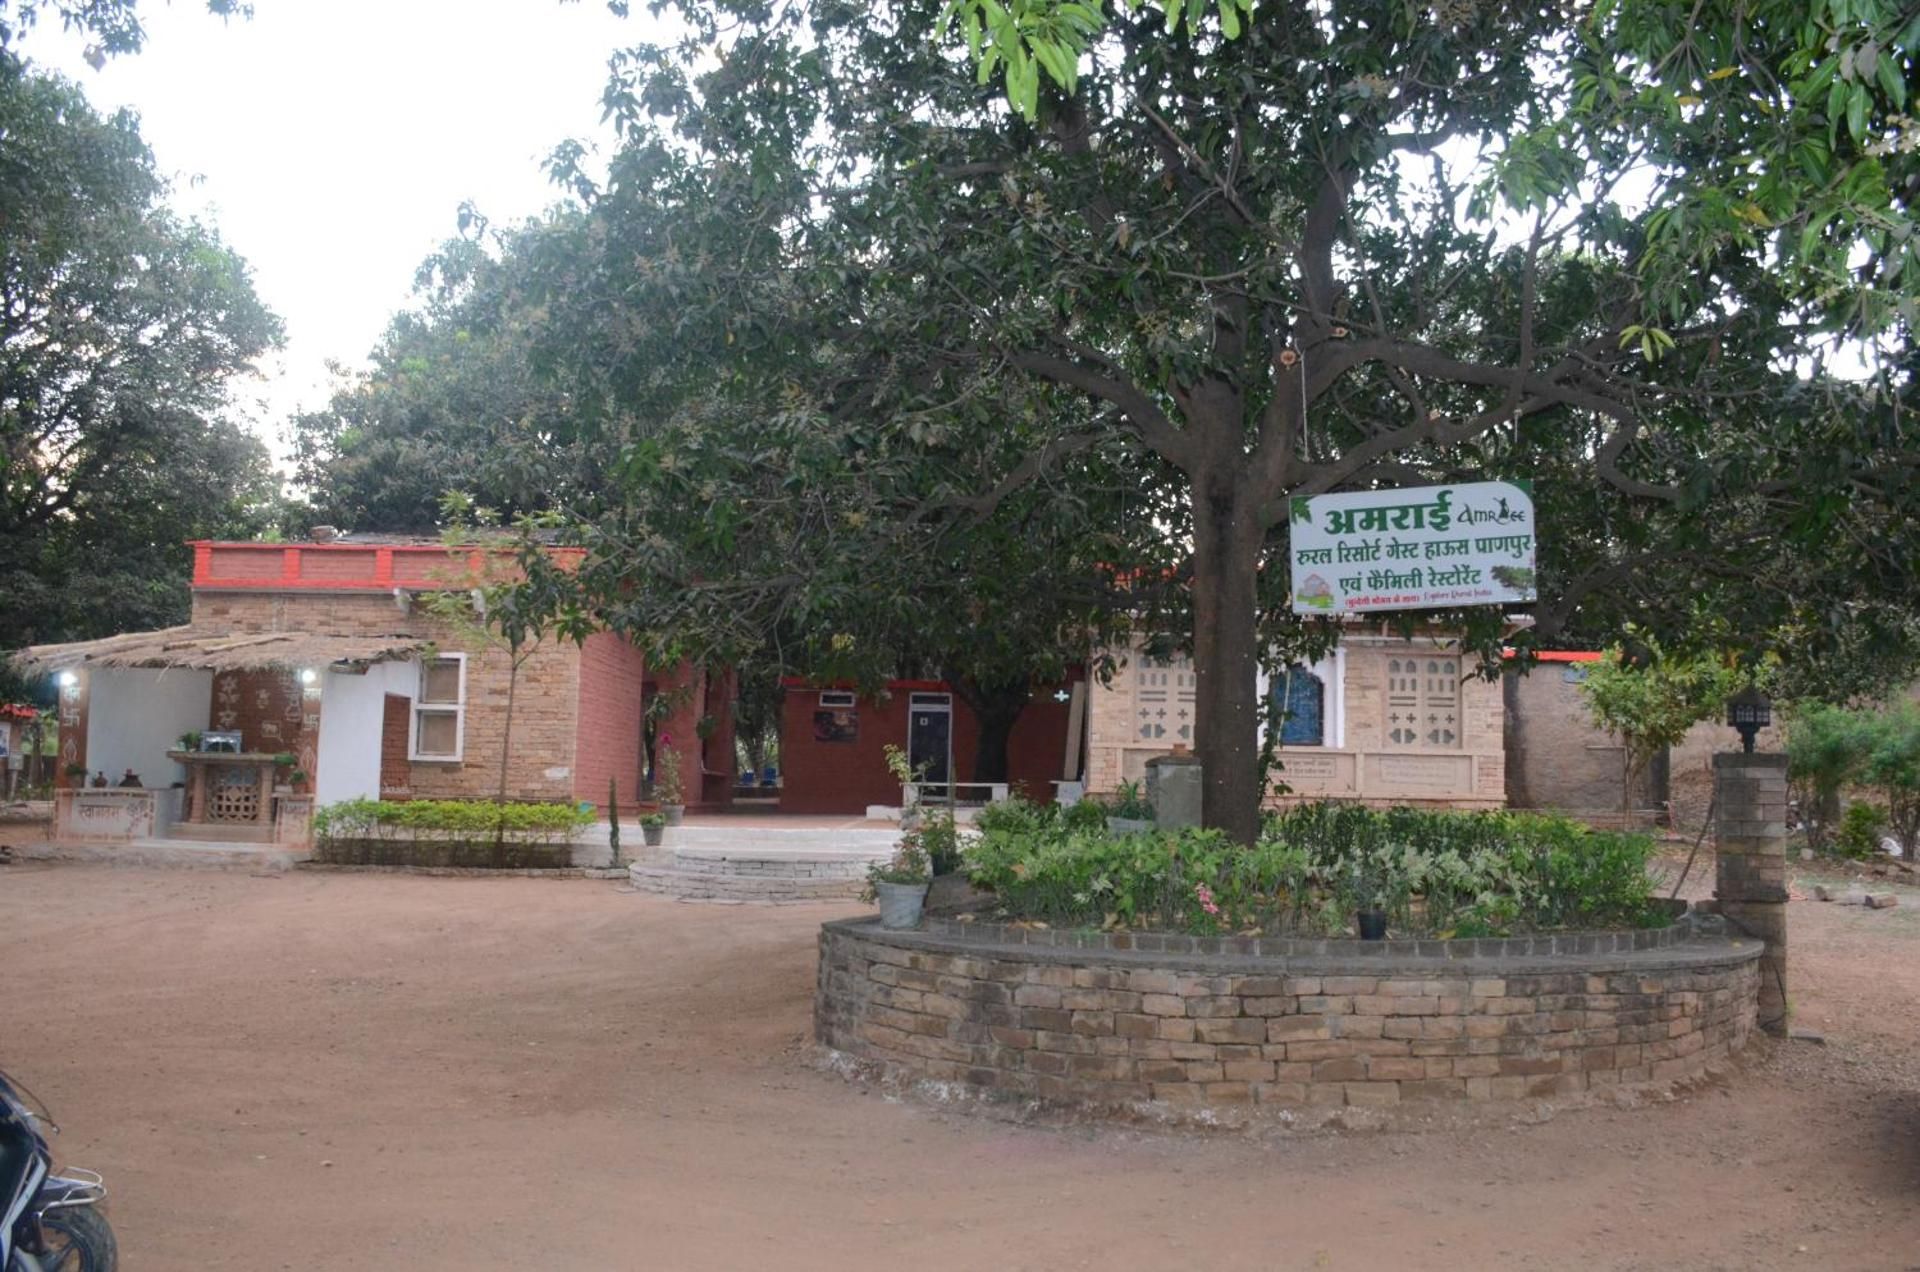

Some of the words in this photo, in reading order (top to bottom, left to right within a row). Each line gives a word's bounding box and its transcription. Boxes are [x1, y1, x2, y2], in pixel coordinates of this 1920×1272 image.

[1324, 490, 1453, 535] अमराई
[1296, 549, 1332, 565] रुरल
[1337, 538, 1381, 563] रिसोर्ट
[1386, 537, 1419, 560] गेस्ट
[1423, 539, 1469, 560] हाऊस
[1338, 571, 1362, 595] एवं
[1367, 567, 1422, 591] फैमिली
[1428, 564, 1481, 588] रेस्टोरेंट
